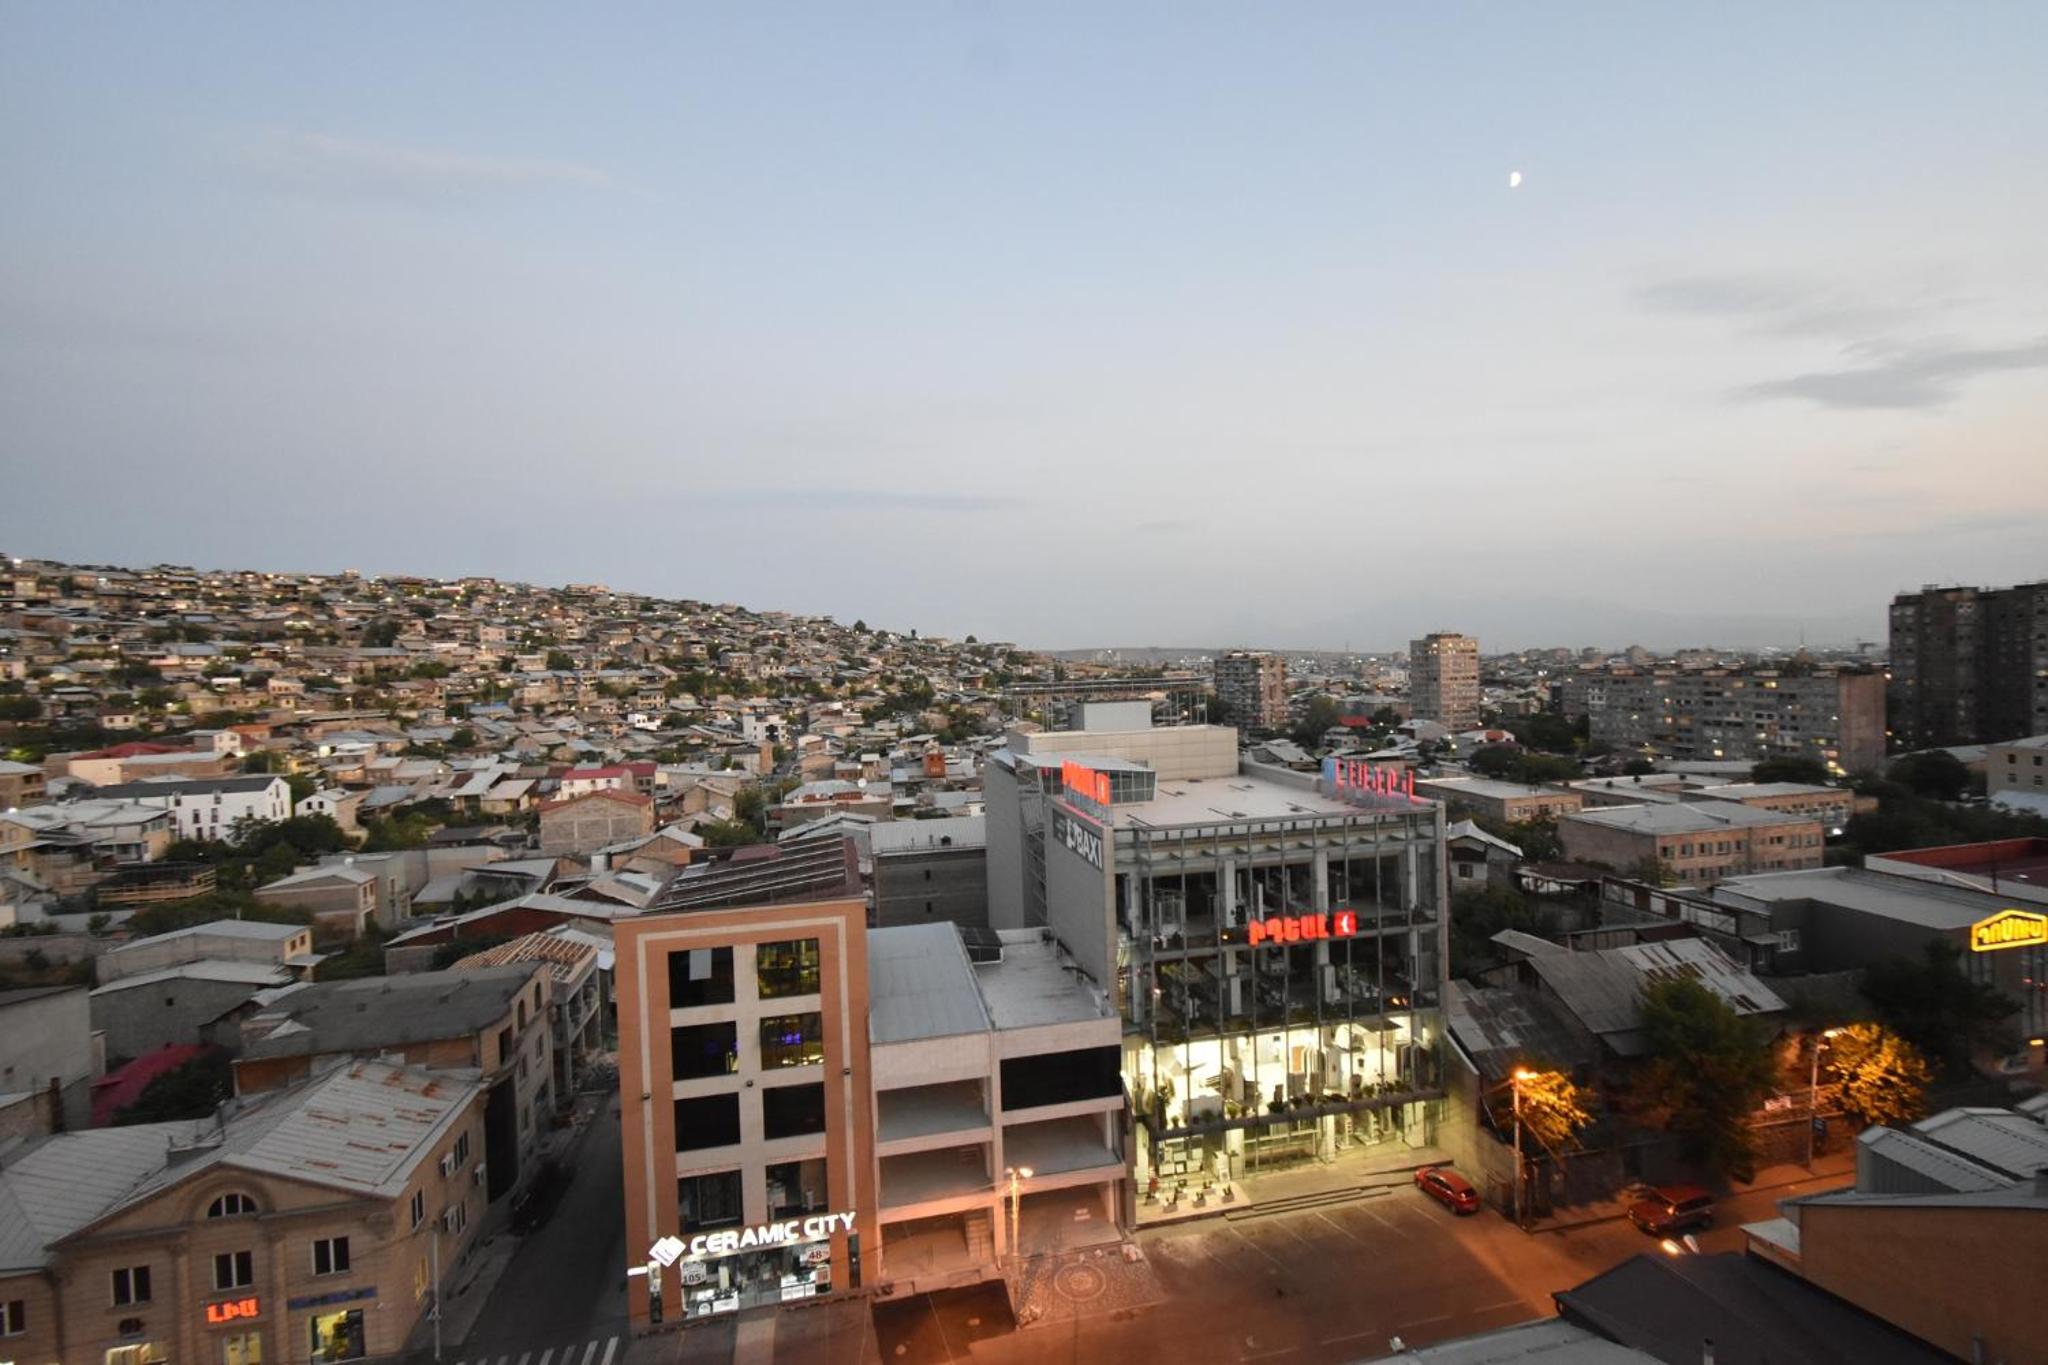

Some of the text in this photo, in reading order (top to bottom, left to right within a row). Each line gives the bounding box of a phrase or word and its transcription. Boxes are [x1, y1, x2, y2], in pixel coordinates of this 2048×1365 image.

[1076, 825, 1103, 869] BAXI
[690, 1211, 857, 1255] CERAMIC CITY
